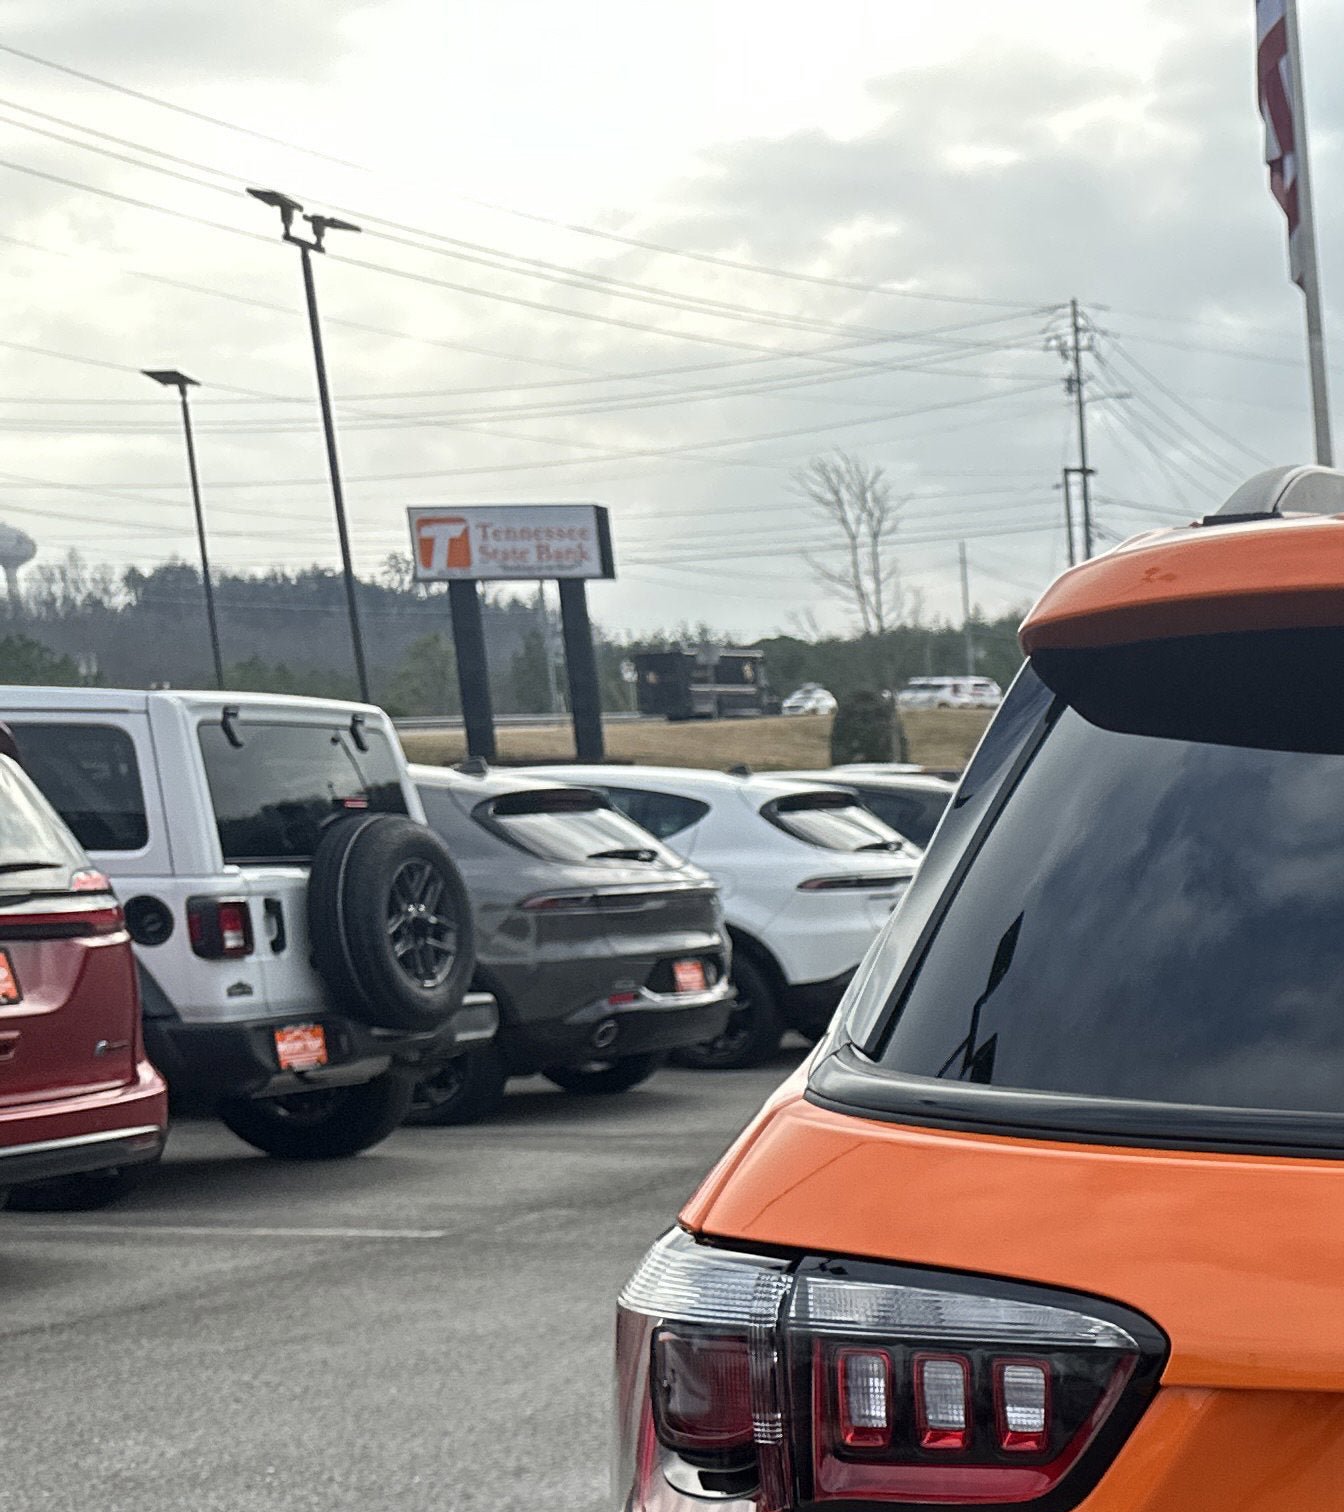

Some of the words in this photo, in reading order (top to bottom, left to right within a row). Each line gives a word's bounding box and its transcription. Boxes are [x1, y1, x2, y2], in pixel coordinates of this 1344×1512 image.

[475, 521, 589, 541] Tennessee
[478, 544, 530, 562] State
[535, 542, 589, 561] Bank
